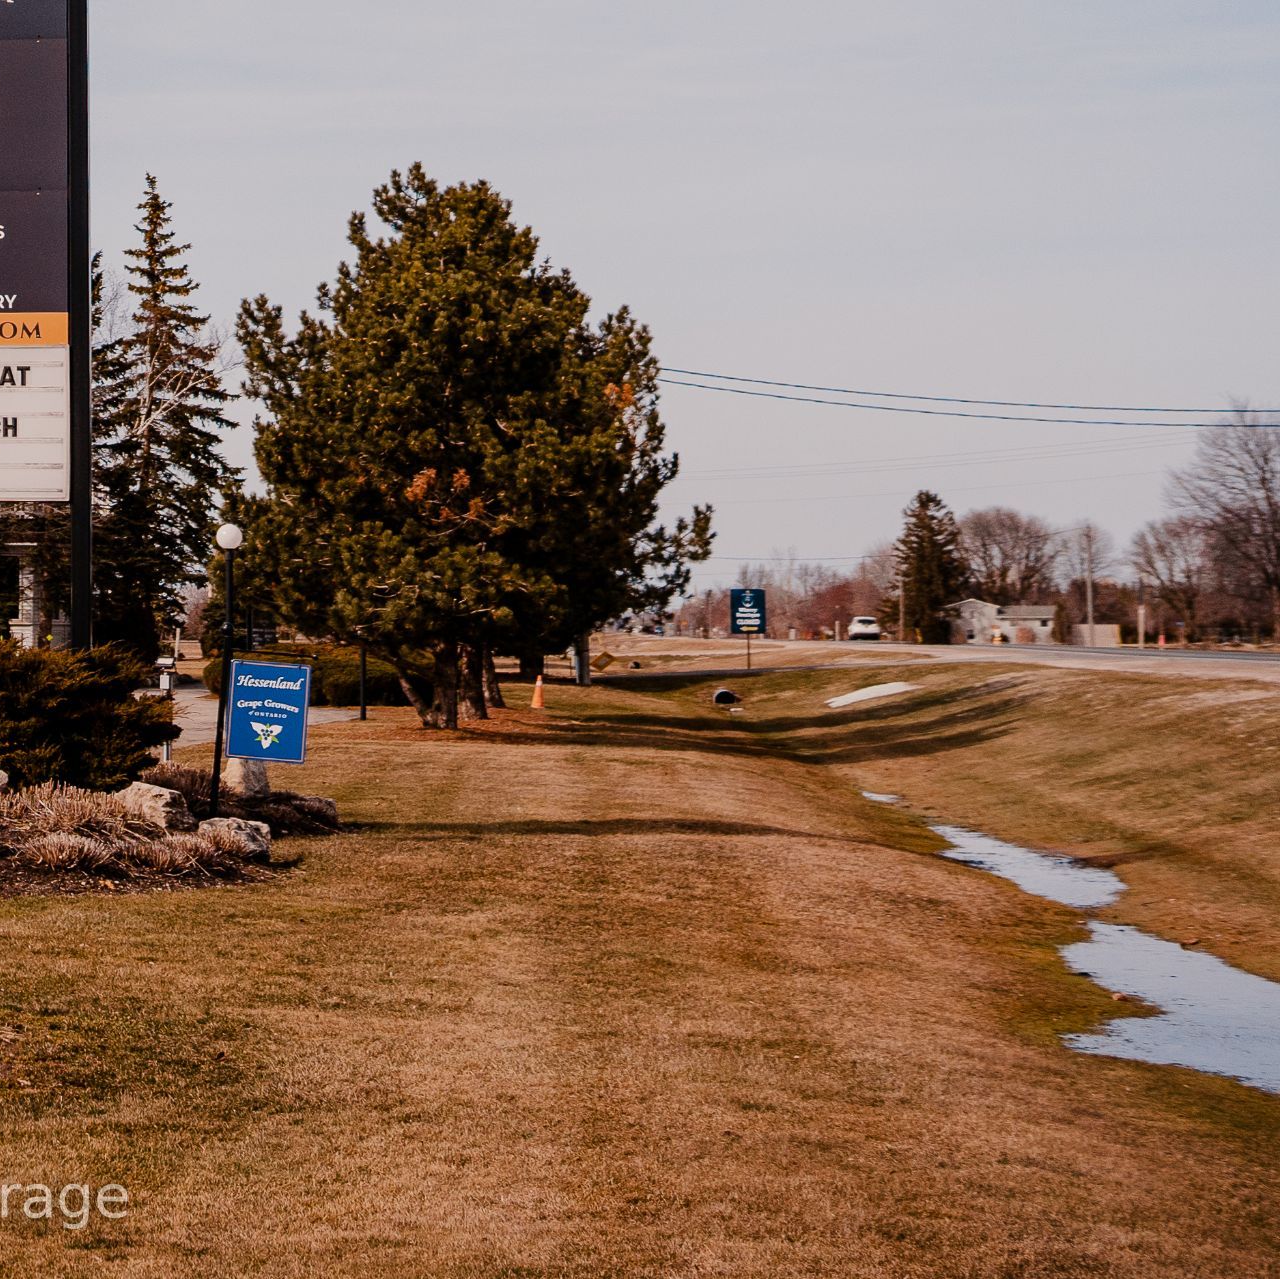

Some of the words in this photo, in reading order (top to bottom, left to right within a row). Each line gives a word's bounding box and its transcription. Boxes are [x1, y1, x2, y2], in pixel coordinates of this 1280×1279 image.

[236, 675, 304, 690] Hessenland
[237, 699, 263, 709] Grape
[264, 699, 299, 713] Growers
